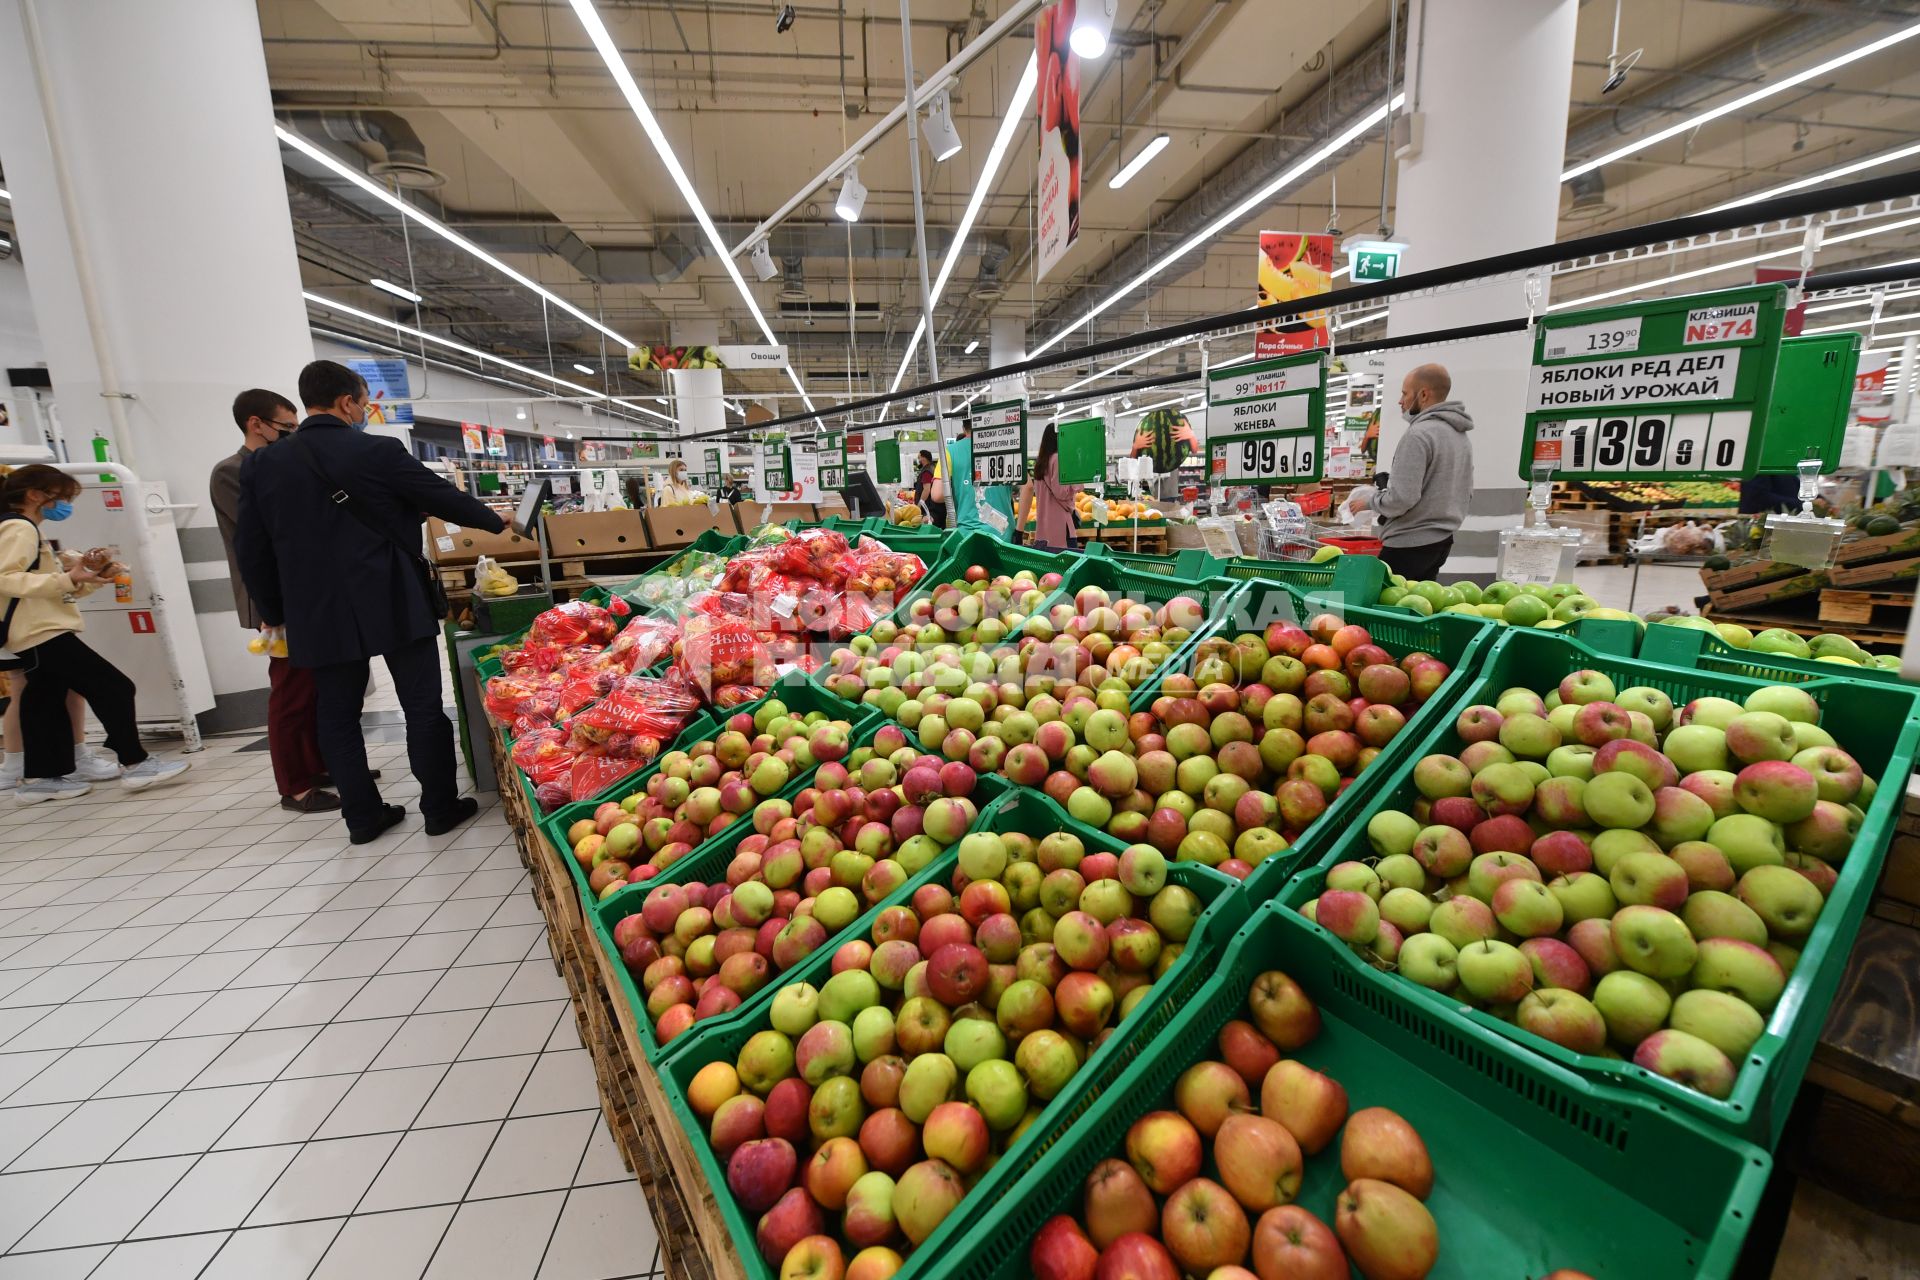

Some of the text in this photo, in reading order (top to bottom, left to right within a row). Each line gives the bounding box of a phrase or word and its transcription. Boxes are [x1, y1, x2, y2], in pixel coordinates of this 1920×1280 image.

[1689, 305, 1756, 321] КЛАВИША
[1686, 319, 1753, 342] №74
[750, 352, 781, 361] Овощи
[1256, 370, 1286, 381] КЛАВИША
[1541, 354, 1725, 384] ЯБЛОКИ РЕД ДЕЛ
[1255, 380, 1286, 394] №117
[1540, 376, 1719, 405] НОВЫЙ УРОЖАЙ
[1233, 402, 1277, 416] ЯБЛОКИ
[997, 427, 1015, 436] СЛАВА
[1234, 418, 1276, 432] ЖЕНЕВА
[1540, 428, 1546, 438] 1
[1009, 438, 1020, 446] ВЕС
[709, 645, 759, 657] свежи
